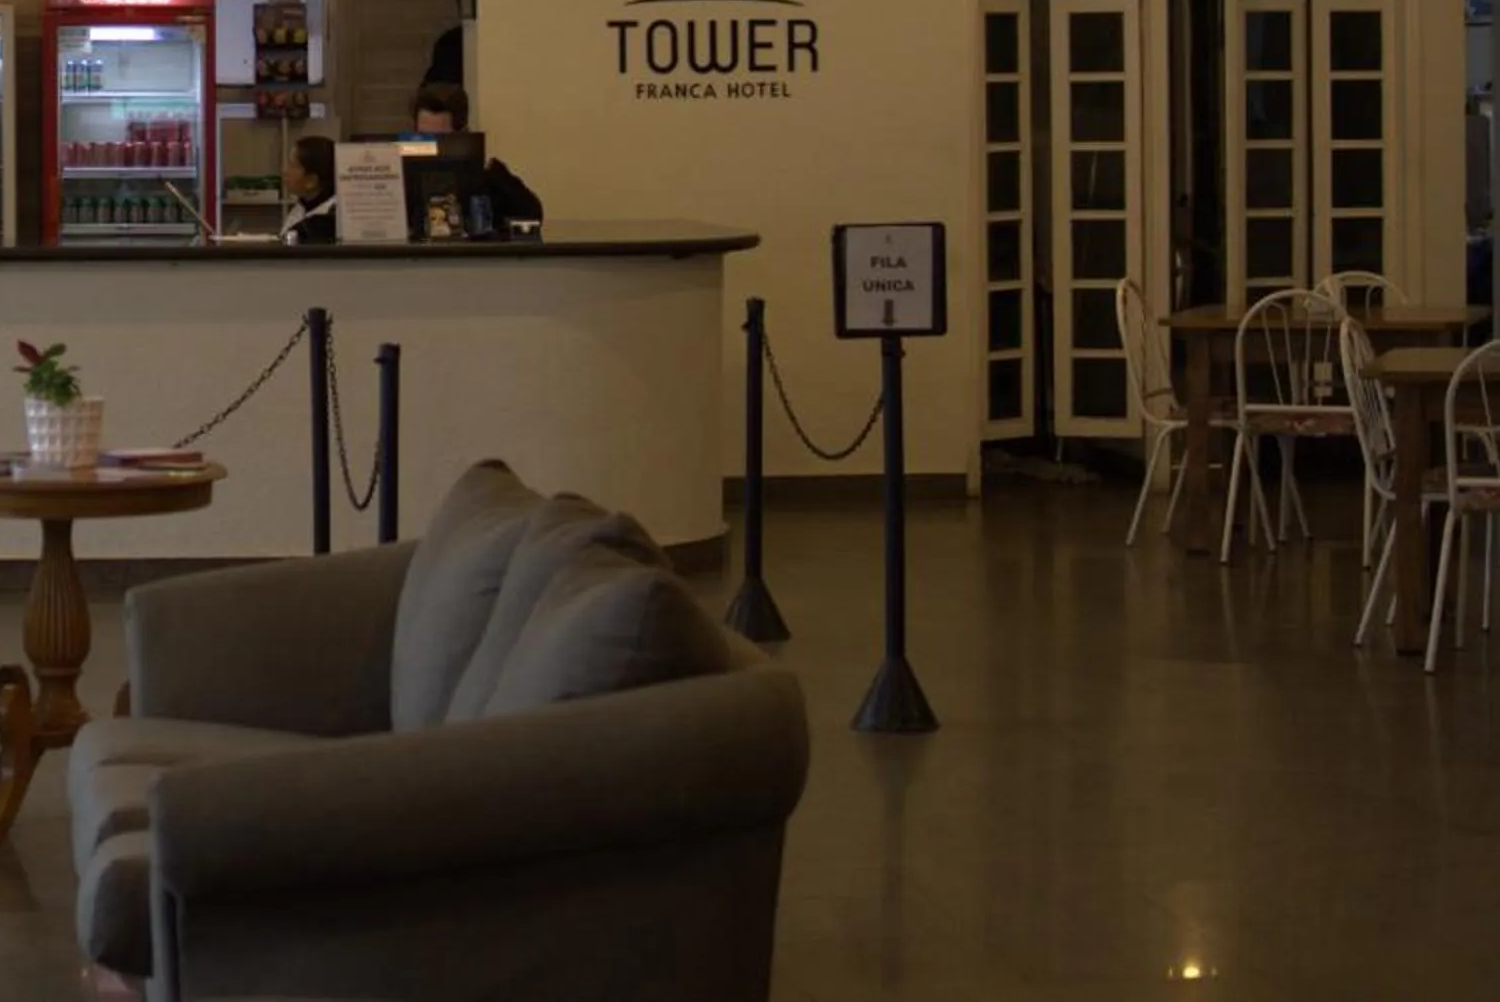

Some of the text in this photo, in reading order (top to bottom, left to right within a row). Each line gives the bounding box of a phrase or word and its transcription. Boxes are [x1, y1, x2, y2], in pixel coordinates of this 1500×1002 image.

[606, 19, 819, 74] TOWER
[636, 82, 792, 99] FRANCA HOTEL
[870, 255, 908, 268] FILA
